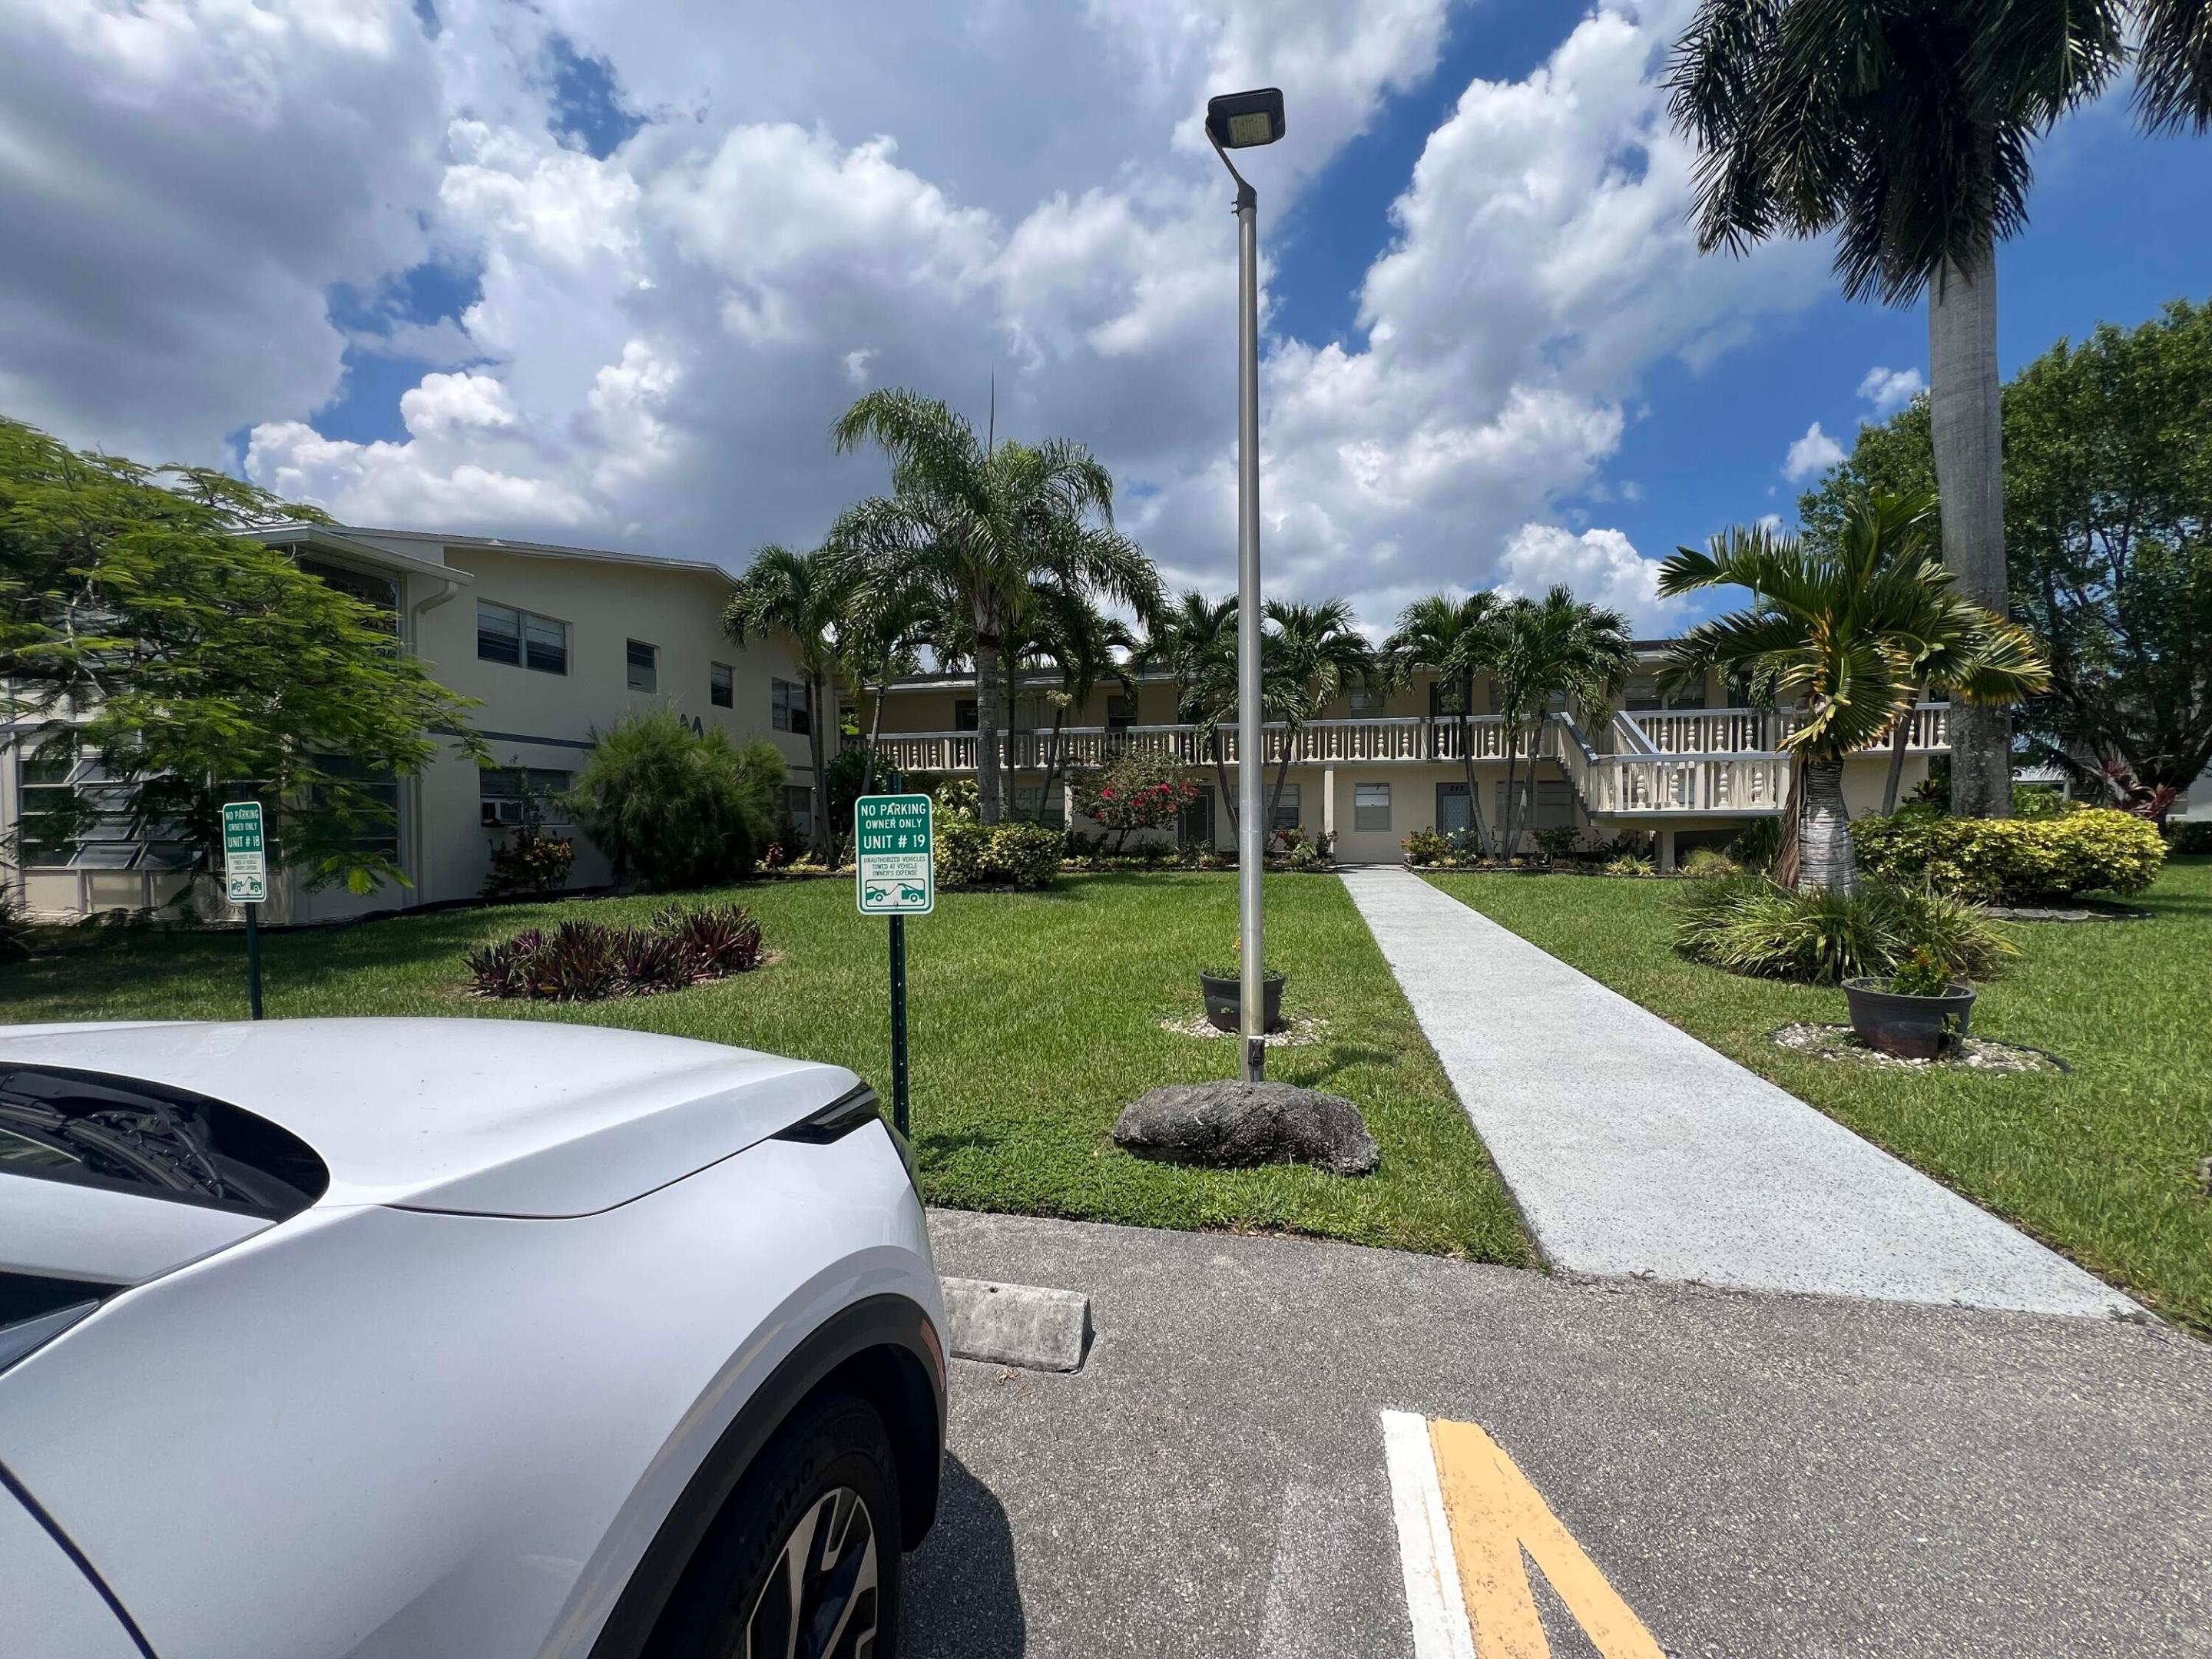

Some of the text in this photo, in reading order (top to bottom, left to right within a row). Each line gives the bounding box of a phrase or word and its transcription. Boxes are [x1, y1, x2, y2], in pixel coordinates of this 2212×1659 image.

[225, 810, 259, 820] NO PARKING
[861, 803, 926, 816] NO PARKING
[228, 823, 257, 832] OWNER ONLY
[866, 818, 922, 830] OWNER ONLY
[227, 835, 260, 848] UNIT # 18
[863, 834, 926, 849] UNIT # 19
